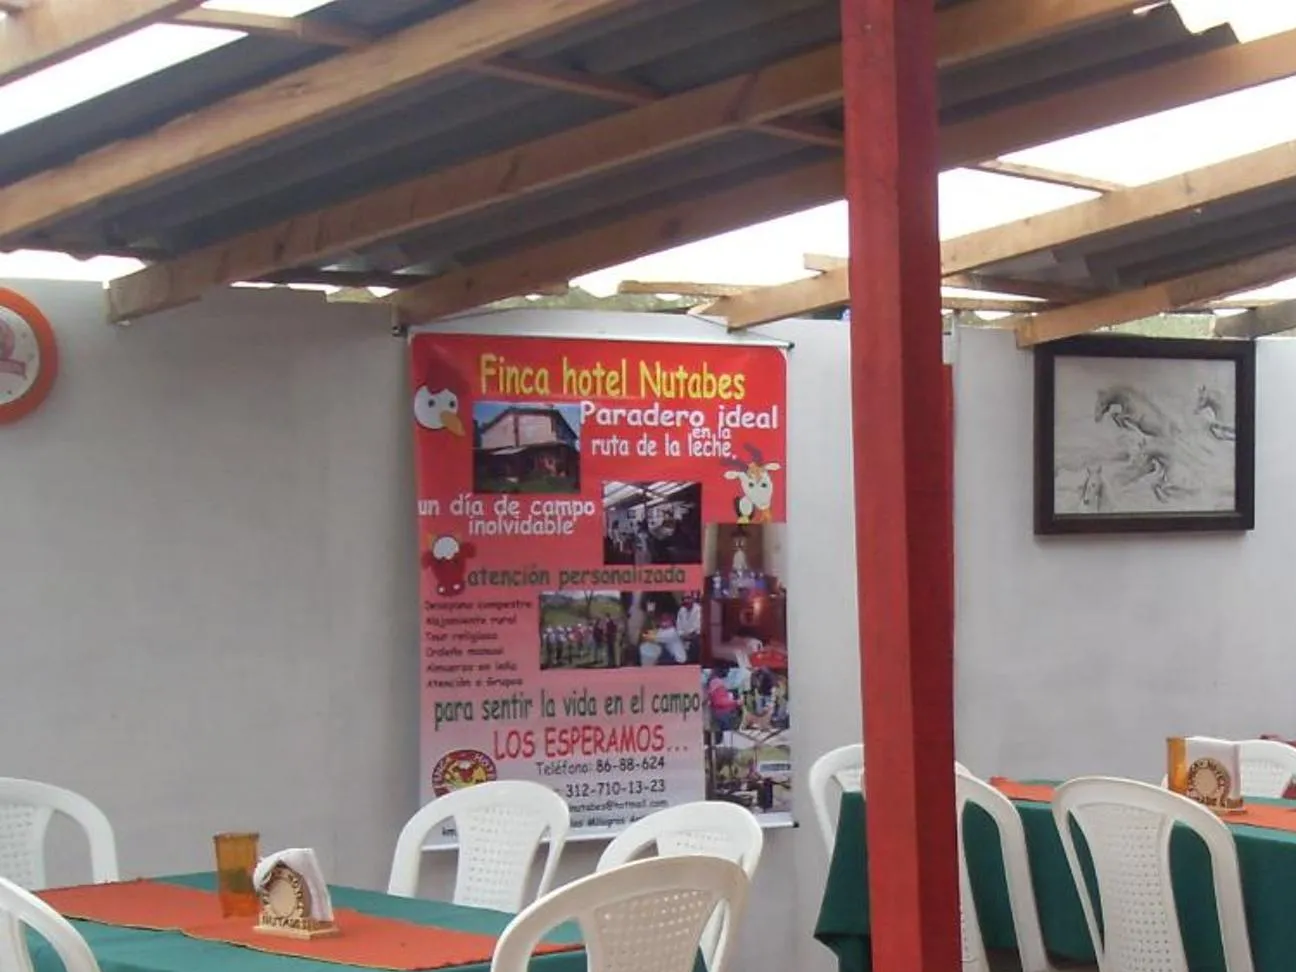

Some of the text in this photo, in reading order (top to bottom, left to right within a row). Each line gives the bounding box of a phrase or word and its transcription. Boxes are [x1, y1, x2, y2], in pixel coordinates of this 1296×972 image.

[480, 353, 746, 400] Finca hotel Nutabes
[580, 400, 779, 429] Paradero ideal
[592, 435, 630, 457] ruta
[637, 433, 657, 457] de
[664, 433, 681, 457] la
[692, 427, 731, 440] en la
[417, 493, 596, 520] un día de campo
[468, 514, 574, 535] inolvidable
[467, 565, 686, 589] atención personalizada
[434, 684, 700, 732] para sentir la vida en el campo
[493, 730, 535, 760] LOS
[596, 756, 665, 773] 86-88-624
[565, 779, 666, 798] 312-710-13-23
